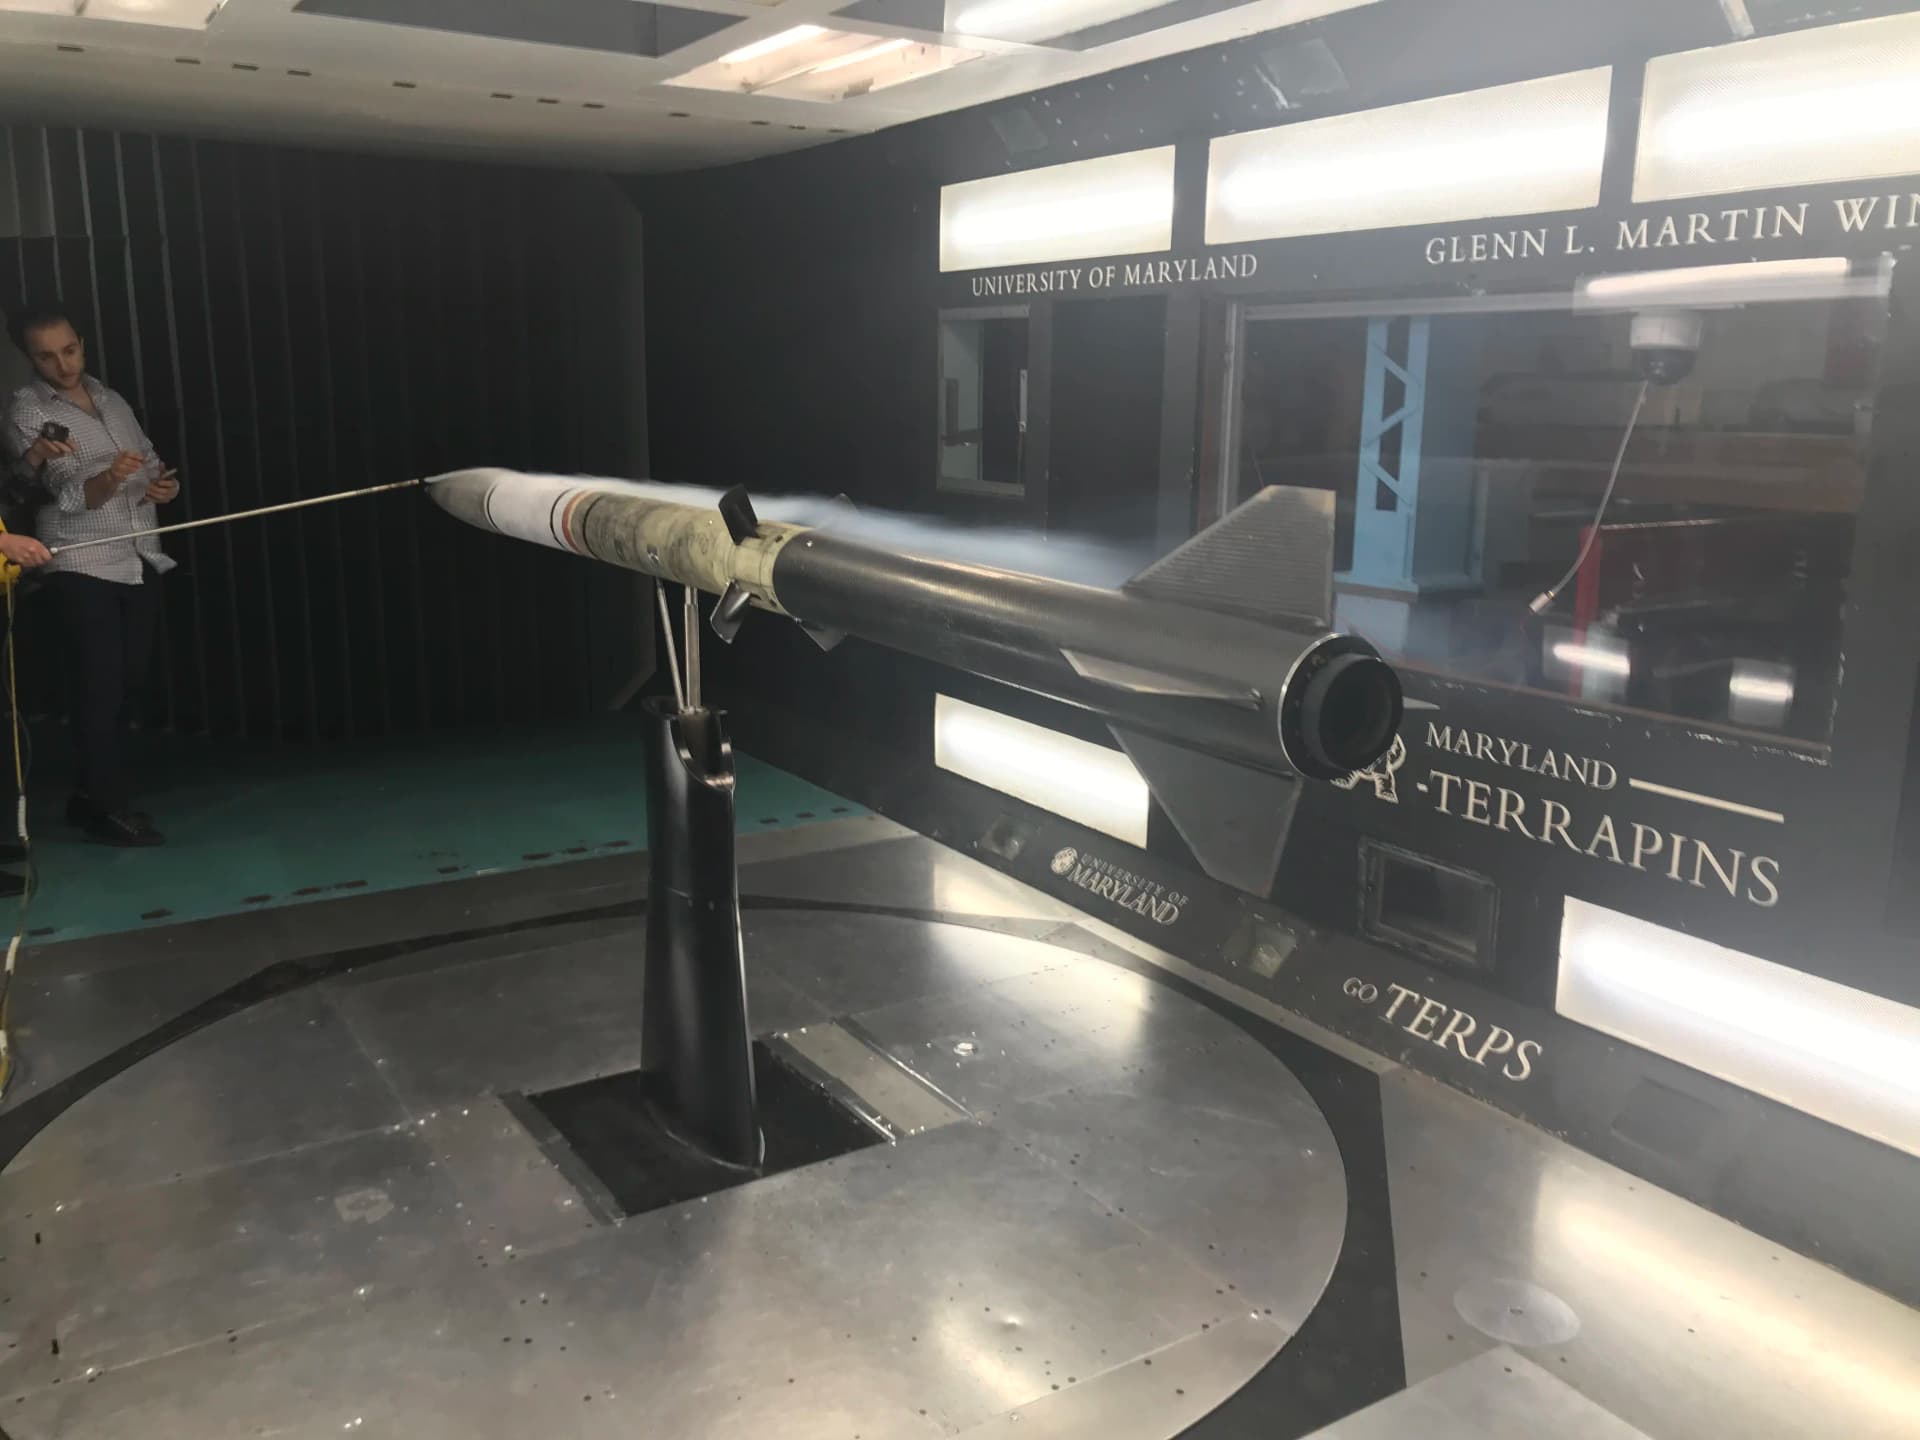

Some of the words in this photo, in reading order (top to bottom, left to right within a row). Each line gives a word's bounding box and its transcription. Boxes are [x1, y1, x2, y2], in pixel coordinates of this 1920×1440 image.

[1425, 229, 1547, 265] GLENN
[1566, 226, 1596, 254] L.
[1616, 203, 1809, 250] MARTIN
[971, 269, 1082, 297] UNIVERSITY
[1089, 266, 1116, 289] OF
[1123, 254, 1258, 286] MARYLAND
[1425, 721, 1618, 790] MARYLAND
[1067, 864, 1181, 926] MARYLAND
[1080, 853, 1166, 895] UNIVERSITY
[1168, 891, 1188, 905] OF
[1343, 977, 1378, 1003] GO
[1379, 982, 1543, 1081] TERPS
